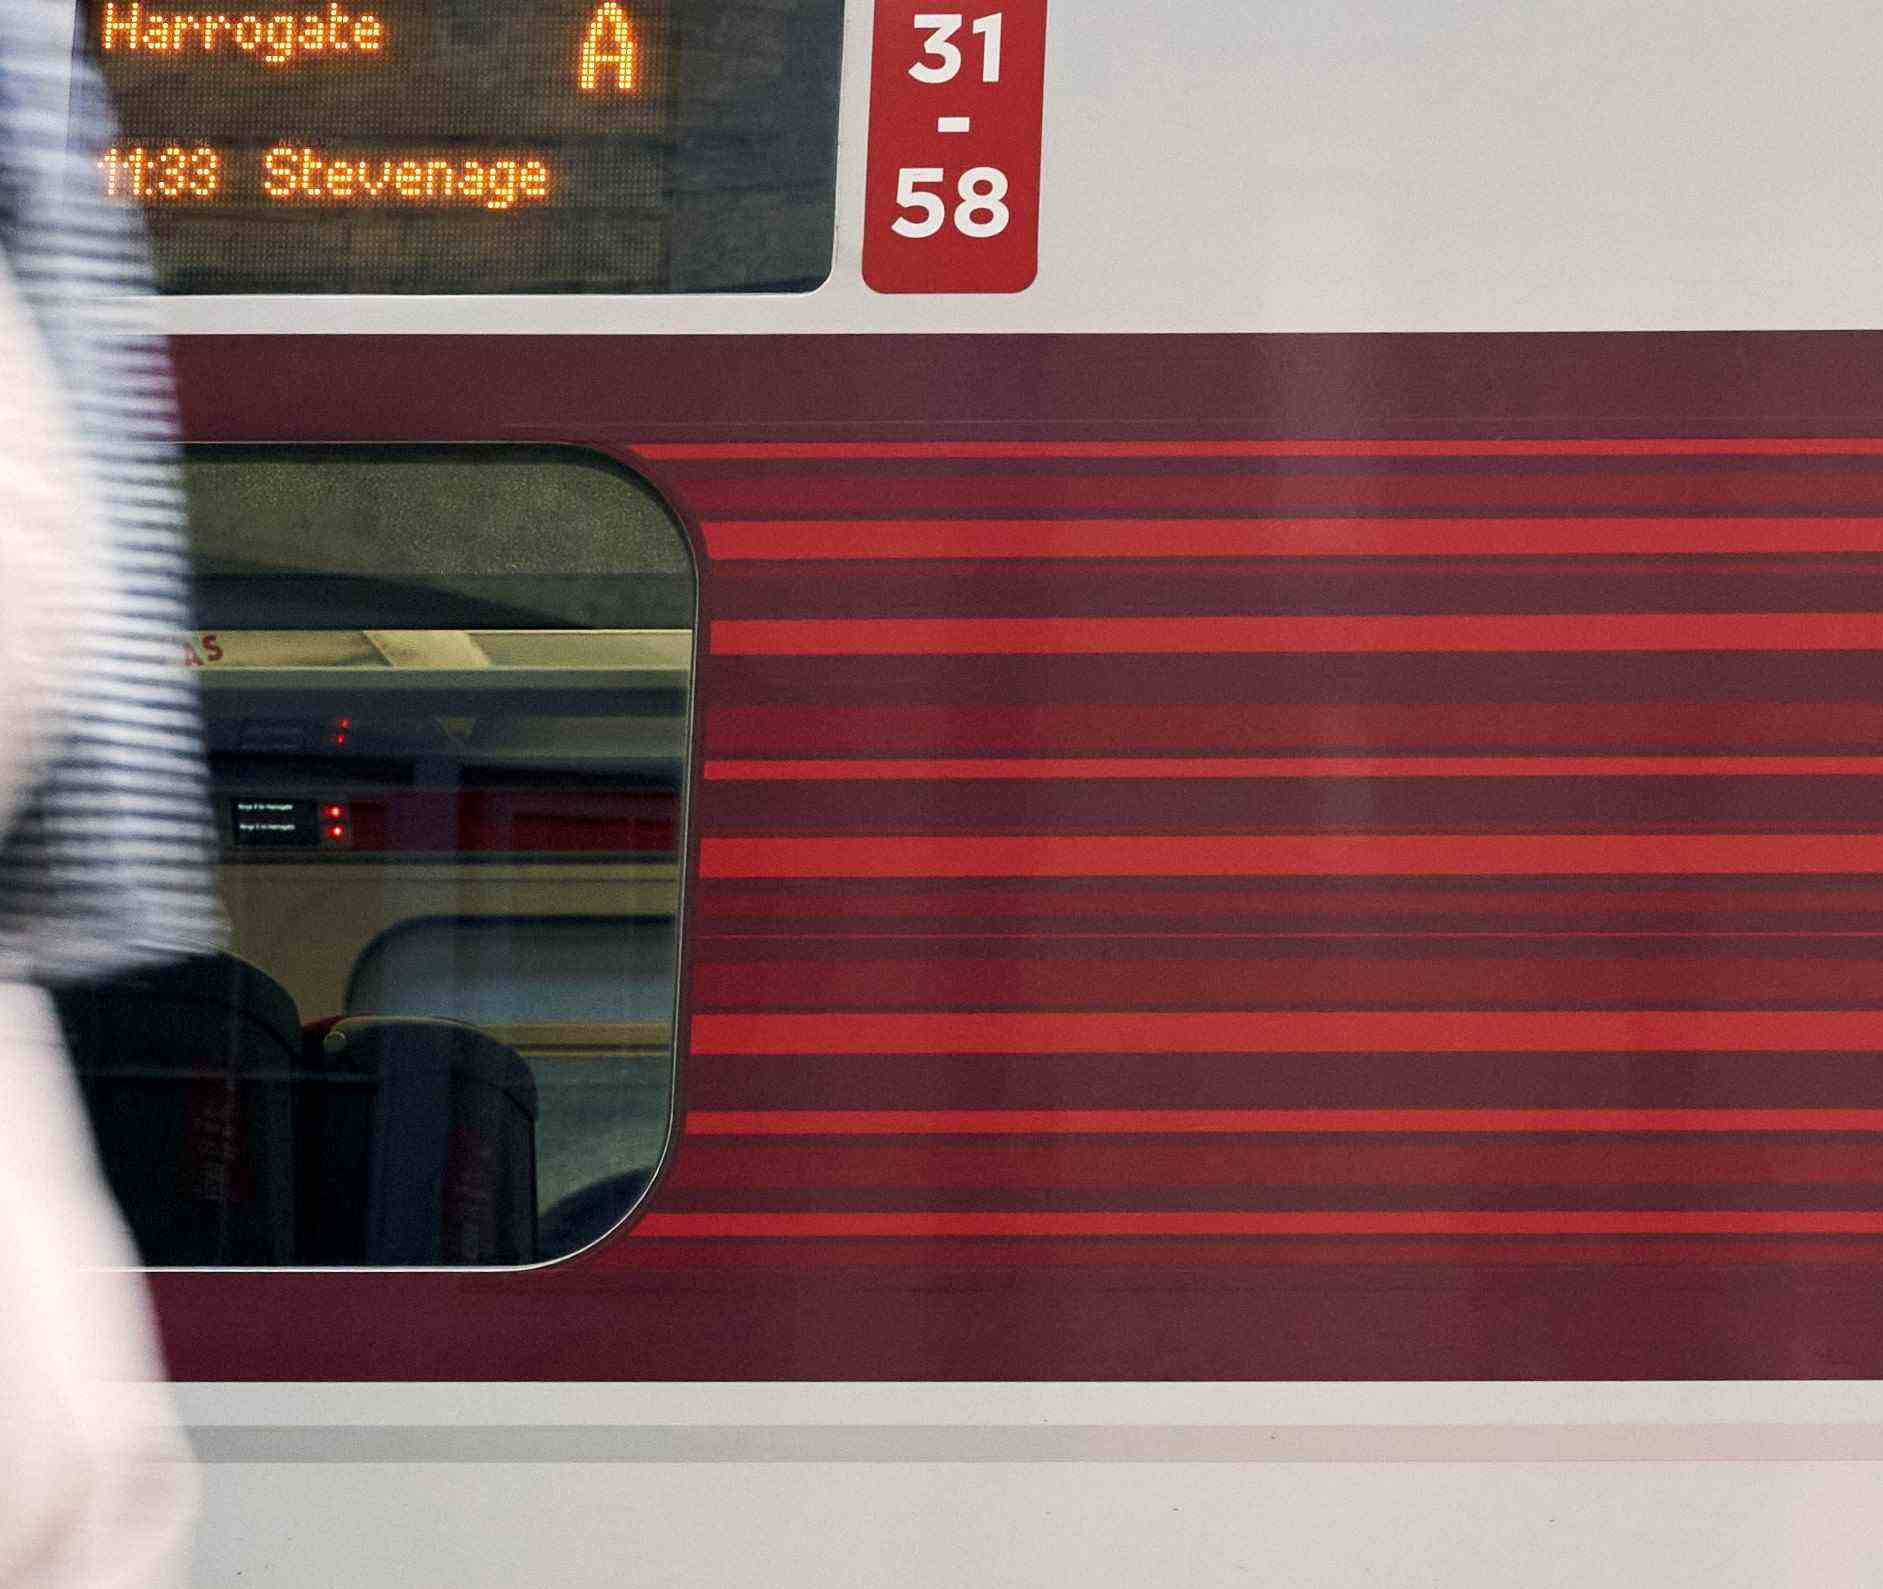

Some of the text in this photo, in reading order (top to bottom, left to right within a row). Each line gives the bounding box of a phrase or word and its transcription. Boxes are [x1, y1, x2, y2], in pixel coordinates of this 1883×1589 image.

[102, 1, 382, 63] Harrogate
[580, 1, 636, 90] A
[909, 13, 1001, 83] 31
[97, 147, 548, 208] 11:33 Stevenage
[892, 167, 1009, 238] 58
